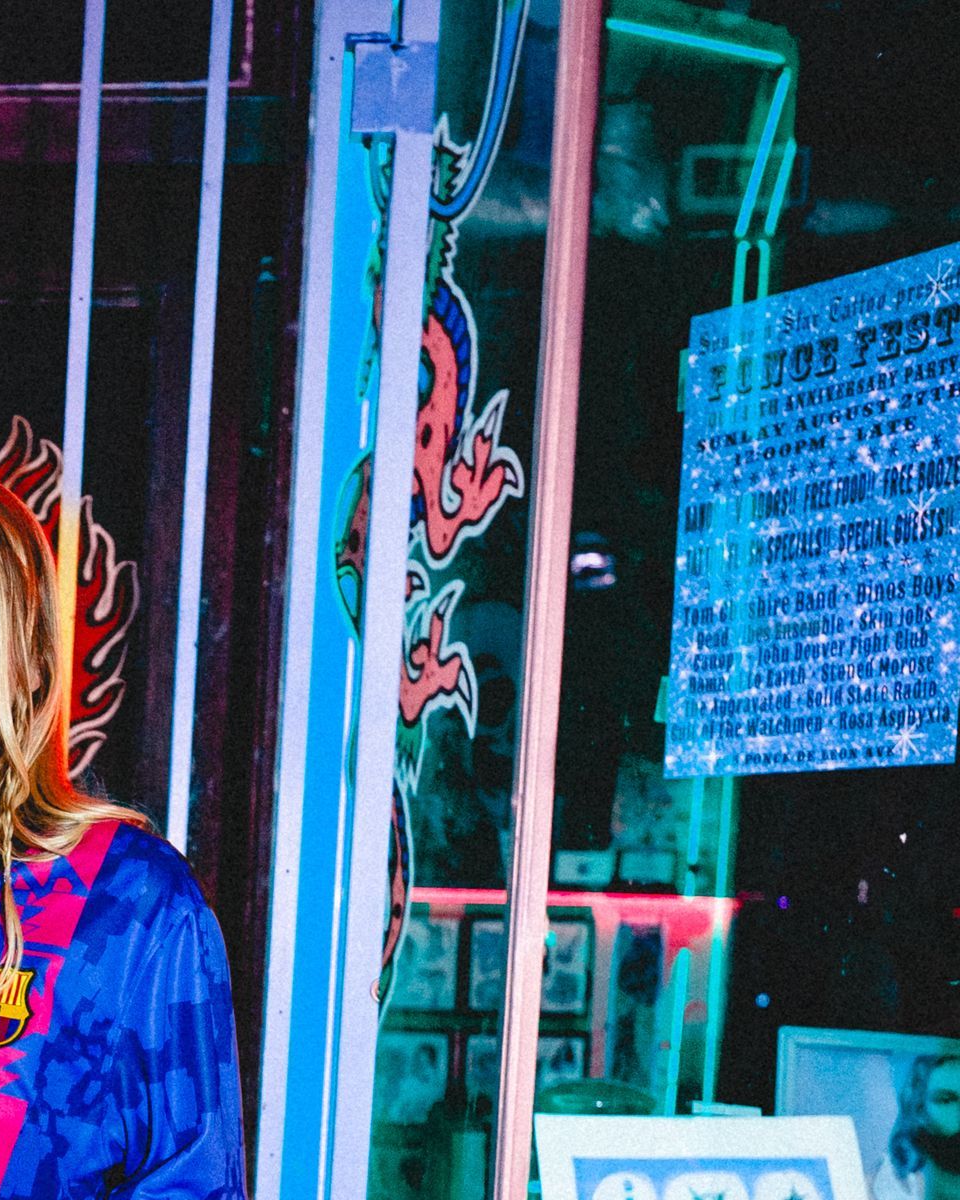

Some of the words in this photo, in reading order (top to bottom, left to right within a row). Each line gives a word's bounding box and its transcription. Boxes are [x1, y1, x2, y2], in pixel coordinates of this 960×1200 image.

[781, 307, 819, 334] Star
[707, 336, 839, 402] PONCE
[849, 301, 960, 369] FEST
[785, 370, 898, 412] ANNIVERSARY
[904, 354, 959, 384] PARTY
[794, 398, 891, 433] AUGUST
[857, 415, 918, 441] LATE
[803, 479, 831, 513] FREE
[882, 463, 913, 498] FREE
[838, 516, 889, 554] SPECIAL
[684, 605, 715, 628] Tom
[796, 583, 838, 613] Band
[857, 579, 906, 605] Dinos
[912, 572, 956, 600] Boys
[696, 626, 729, 650] Dead
[774, 612, 843, 641] Ensemble
[859, 608, 894, 633] Skin
[899, 603, 934, 628] Jobs
[758, 642, 791, 668] John
[850, 631, 889, 657] Fight
[895, 626, 929, 652] Club
[766, 665, 806, 689] Earth
[821, 658, 874, 683] Stoned
[880, 655, 935, 678] Morose
[712, 690, 792, 719] Aggravated
[806, 684, 842, 709] Solid
[848, 682, 888, 705] State
[893, 678, 937, 702] Radio
[746, 712, 822, 737] Watchmen
[839, 710, 873, 731] Rosa
[744, 752, 790, 765] PONCE
[797, 750, 814, 763] DE
[821, 748, 857, 761] LEON
